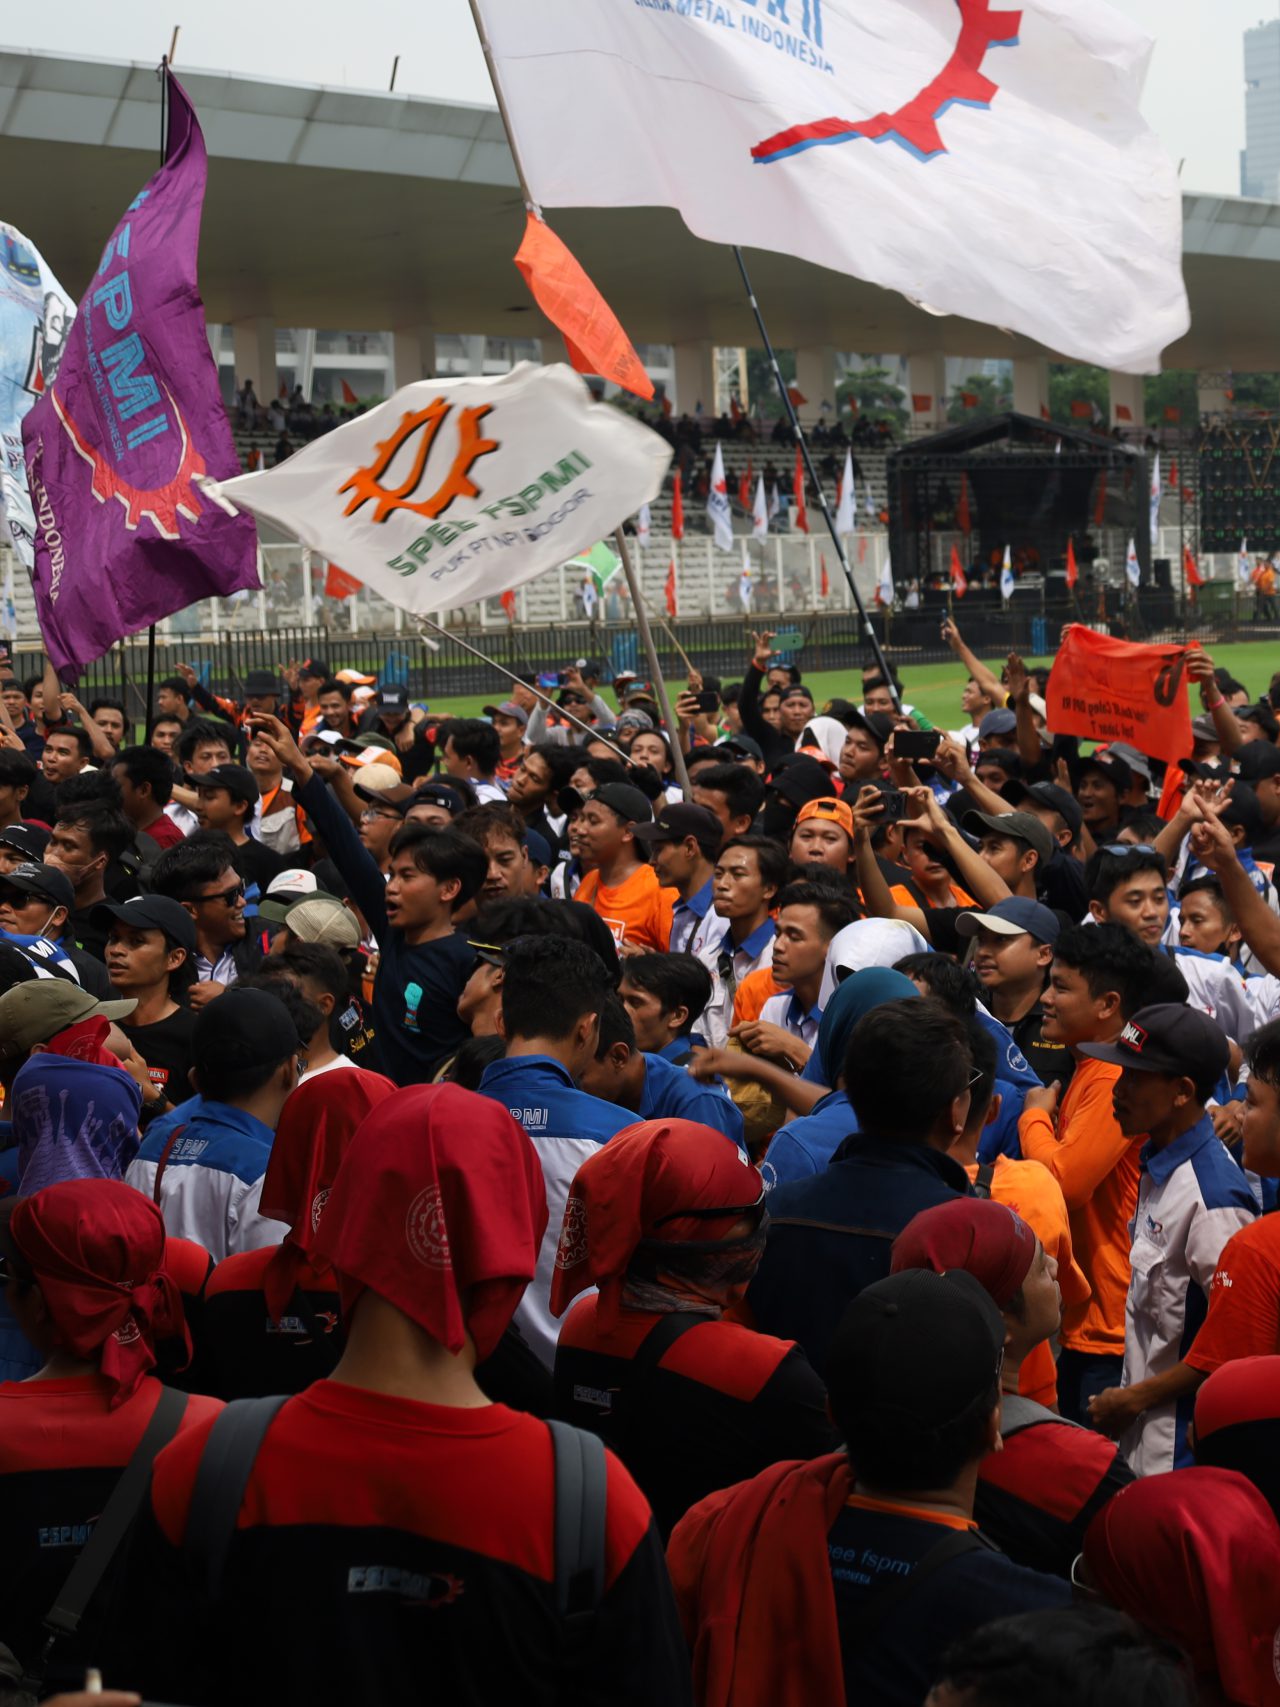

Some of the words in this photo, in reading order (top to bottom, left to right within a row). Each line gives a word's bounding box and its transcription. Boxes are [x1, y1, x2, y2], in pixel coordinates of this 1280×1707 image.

[93, 190, 169, 451] SPMI
[509, 1108, 548, 1125] PMI
[171, 1138, 209, 1155] SPMI
[861, 1548, 918, 1577] fspm
